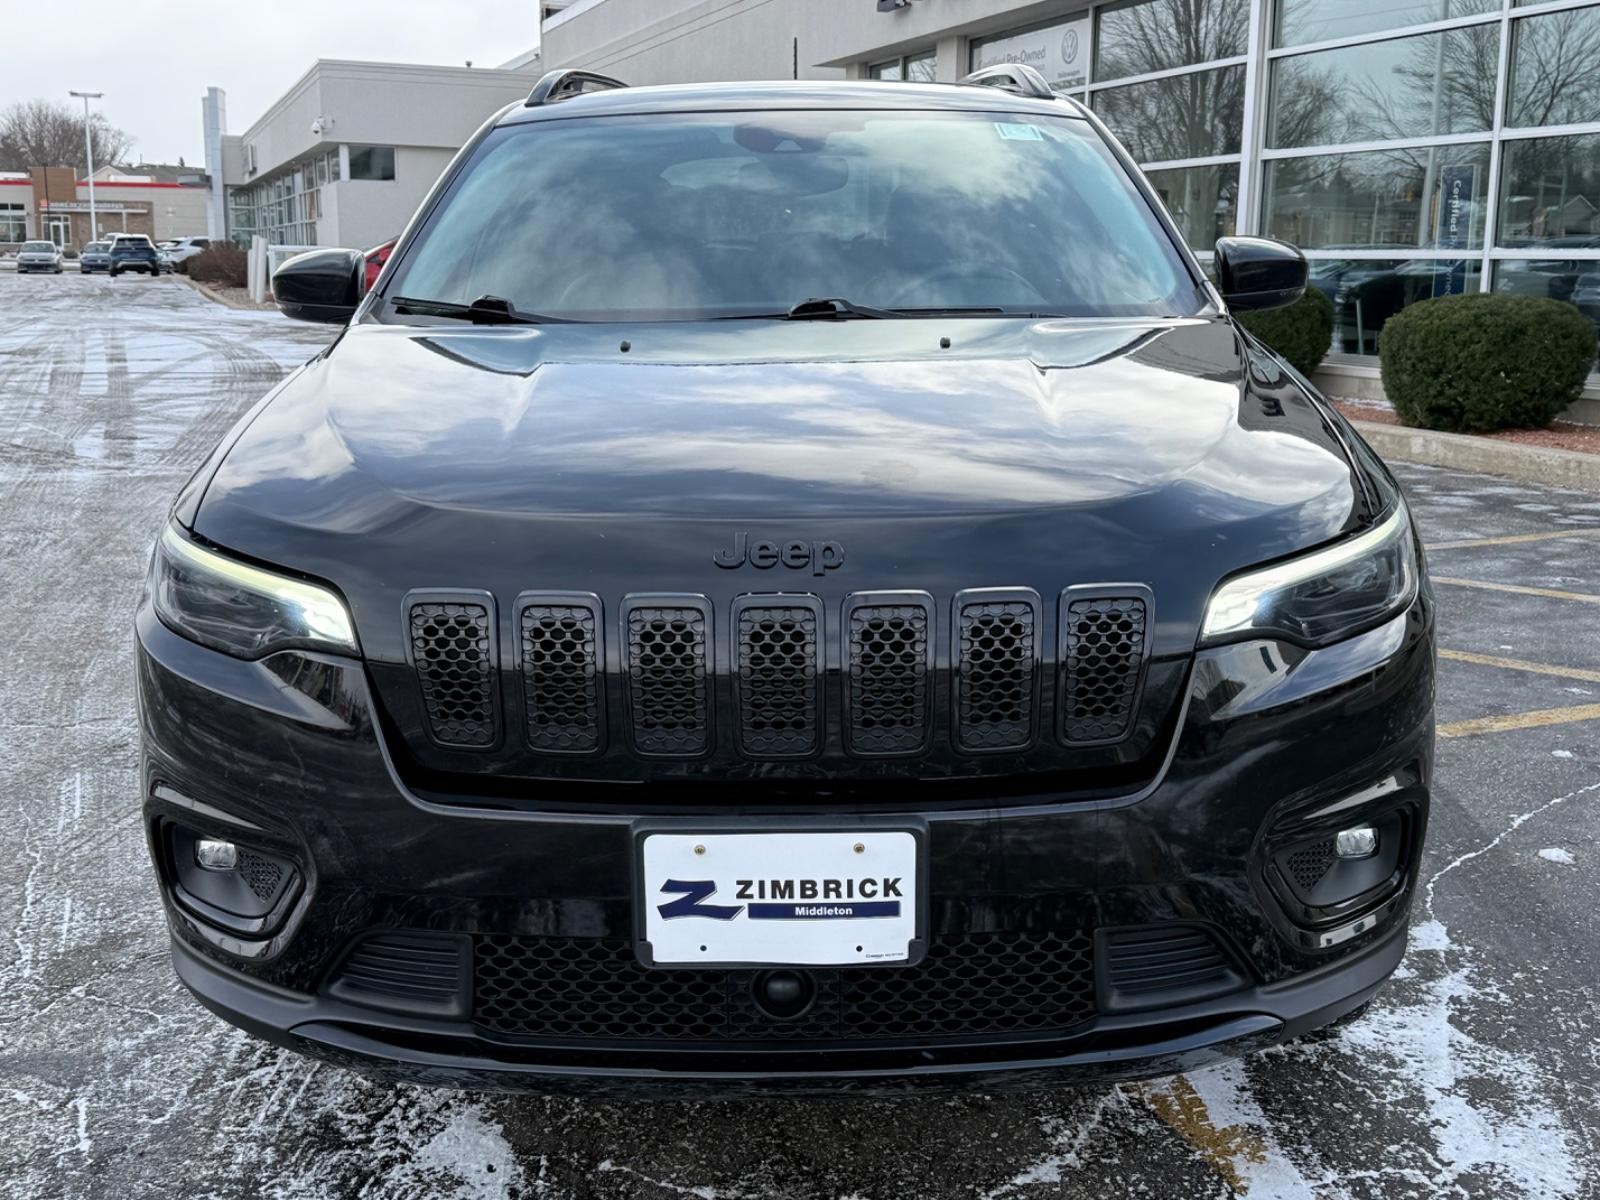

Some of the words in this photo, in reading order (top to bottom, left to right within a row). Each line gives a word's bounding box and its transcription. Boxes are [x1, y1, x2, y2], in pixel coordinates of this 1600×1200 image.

[713, 531, 845, 577] Jeep
[736, 877, 903, 899] ZIMBRICK
[795, 906, 853, 916] Middleton
